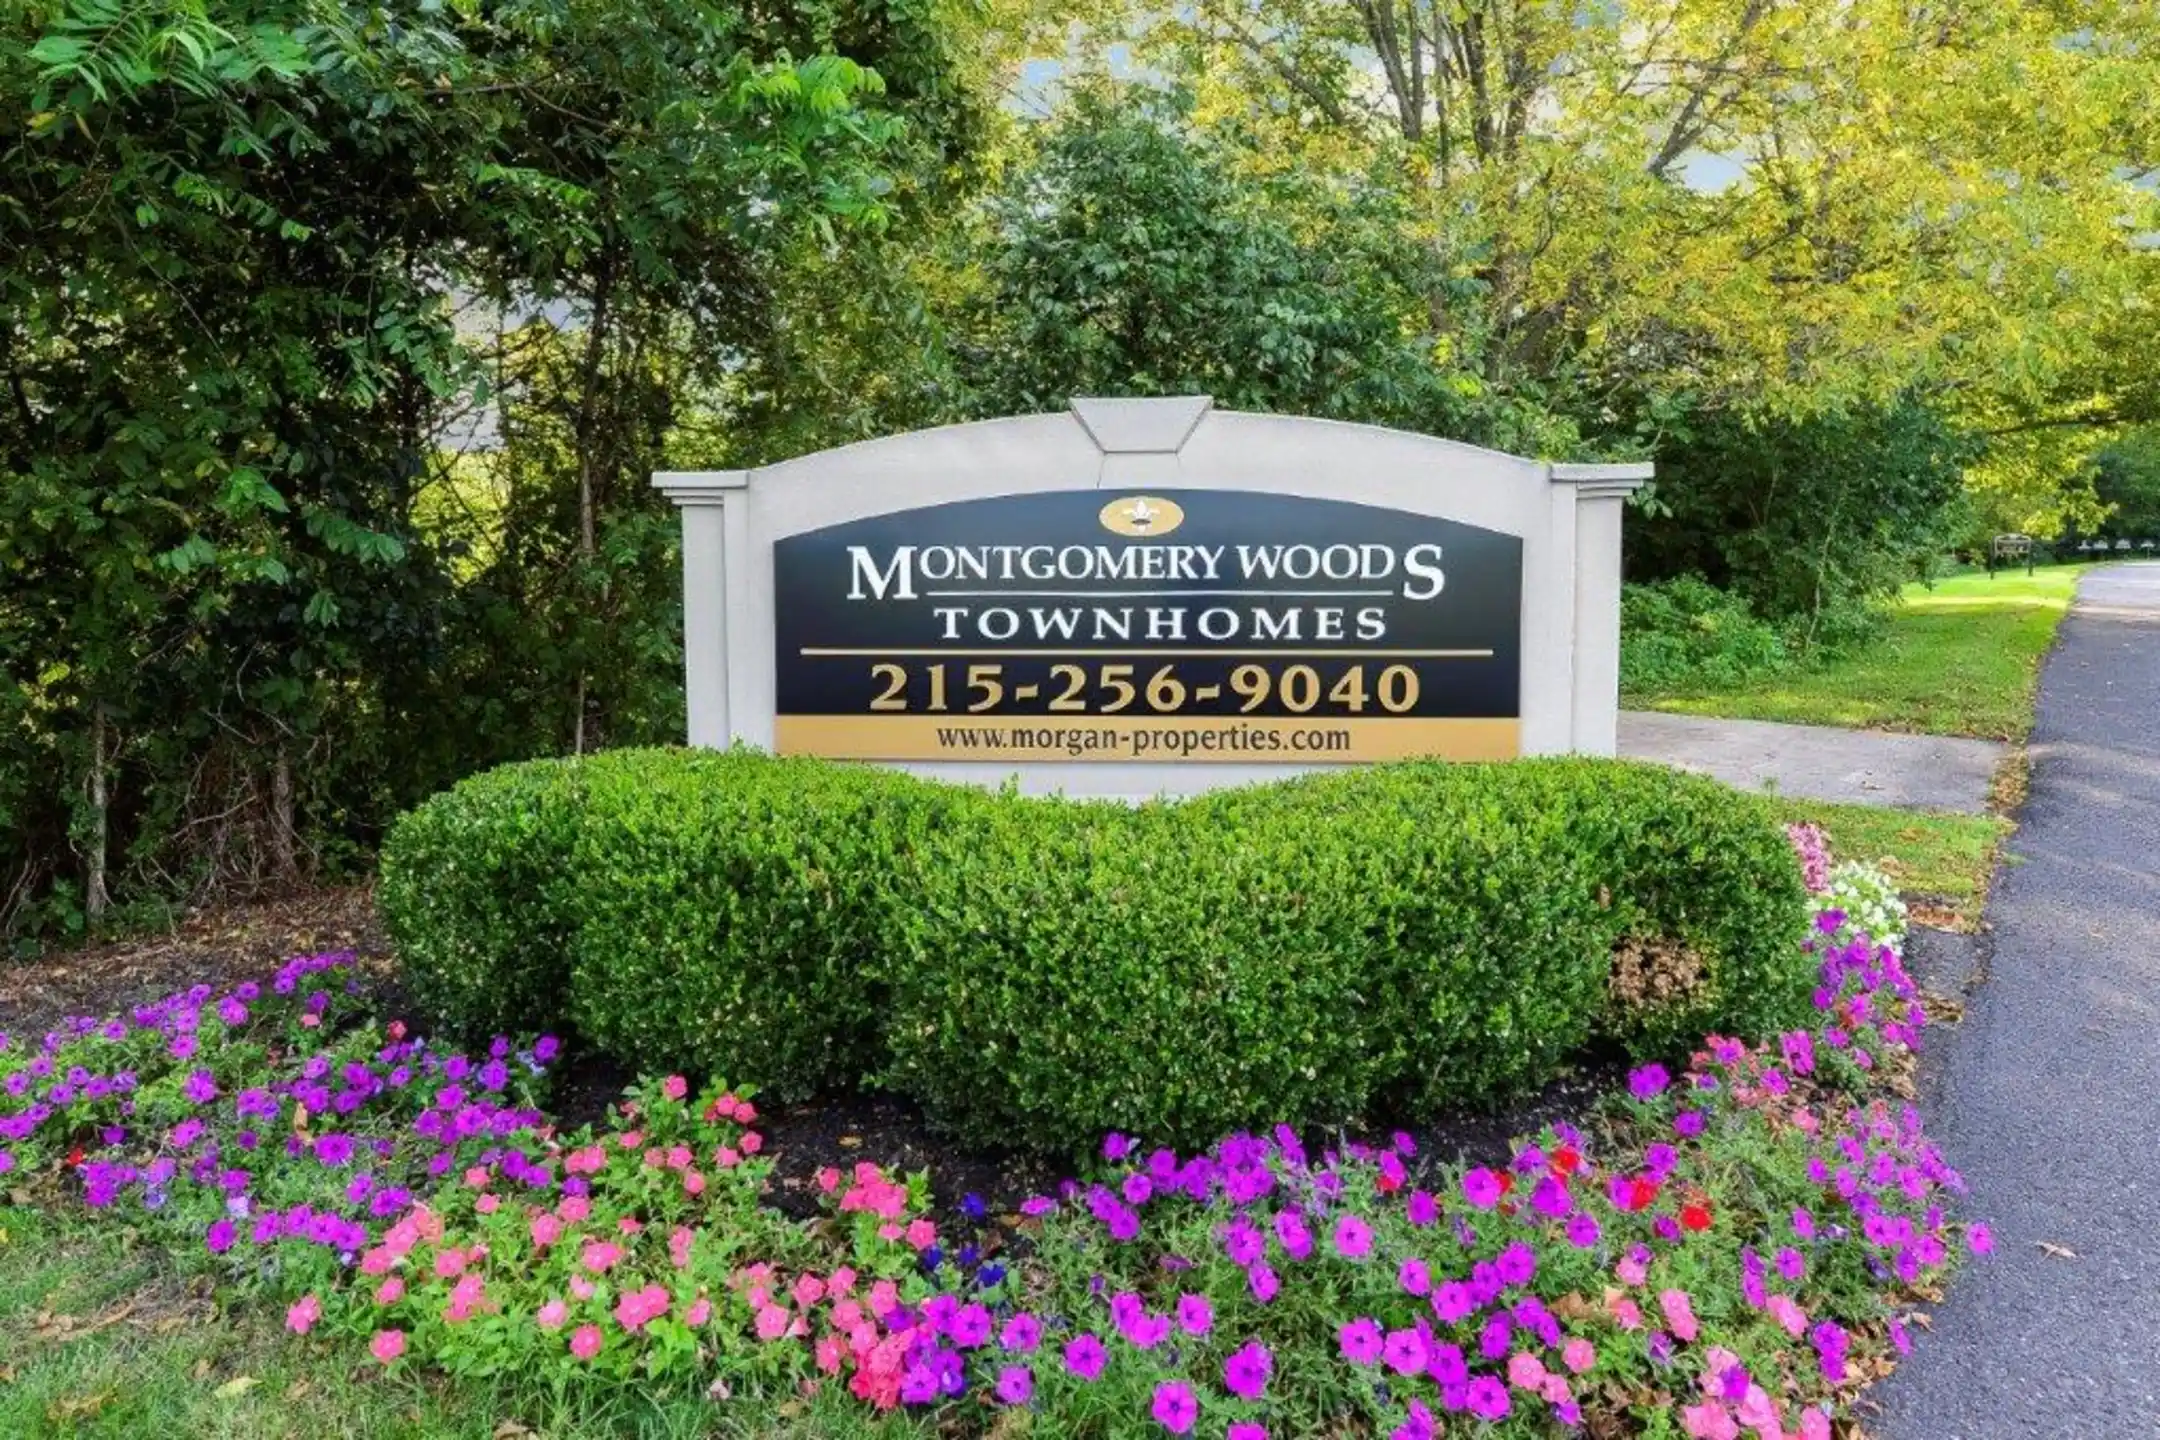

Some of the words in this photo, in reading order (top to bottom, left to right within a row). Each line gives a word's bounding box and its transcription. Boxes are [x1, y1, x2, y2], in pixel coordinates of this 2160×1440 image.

[847, 545, 1225, 600] MONTGOMERY
[1236, 544, 1445, 600] WOODS
[933, 607, 1387, 640] TOWNHOMES
[869, 663, 1420, 713] 215-256-9040
[937, 723, 1351, 756] www.morgan-properties.com
